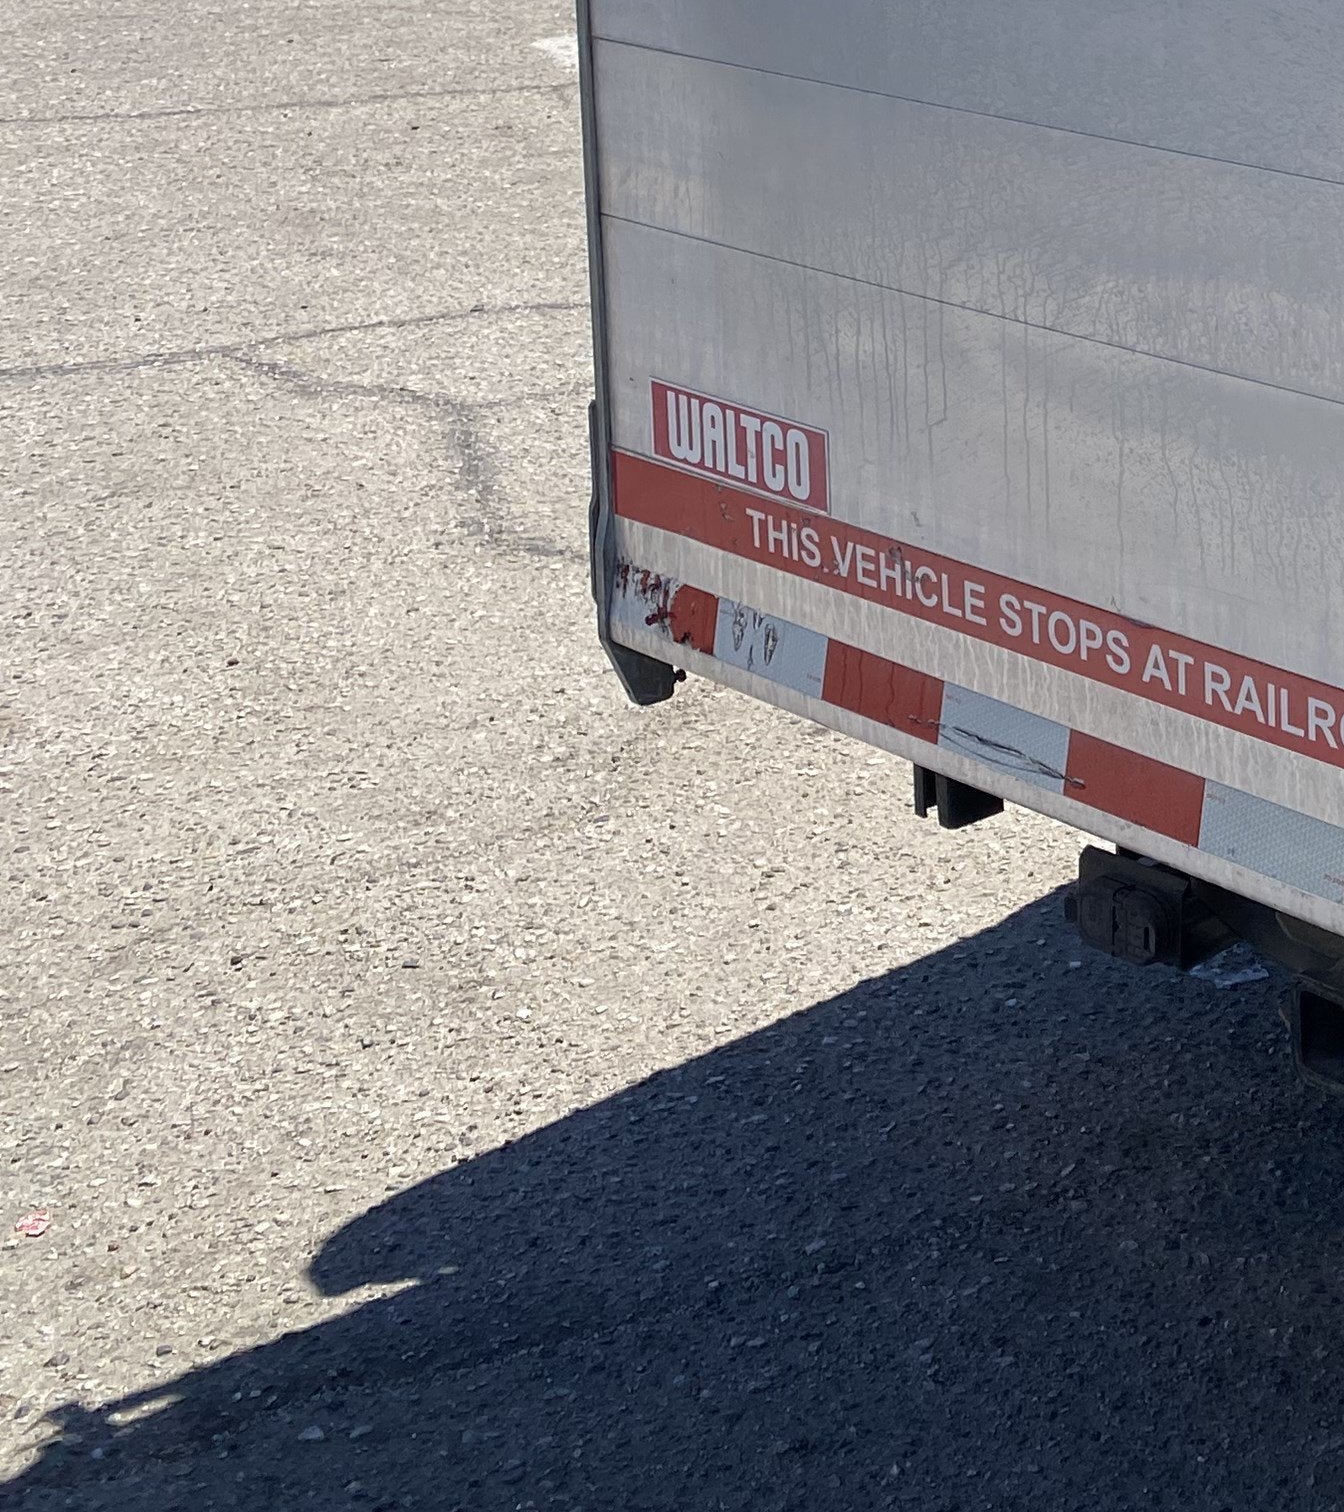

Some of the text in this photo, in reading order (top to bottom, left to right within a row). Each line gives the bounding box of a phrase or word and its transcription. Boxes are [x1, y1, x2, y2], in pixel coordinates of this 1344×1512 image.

[665, 391, 811, 502] WALTCO
[746, 507, 822, 569] THIS
[828, 534, 988, 627] VEHICLE
[998, 593, 1132, 676] STOPS
[1141, 644, 1194, 696] AT
